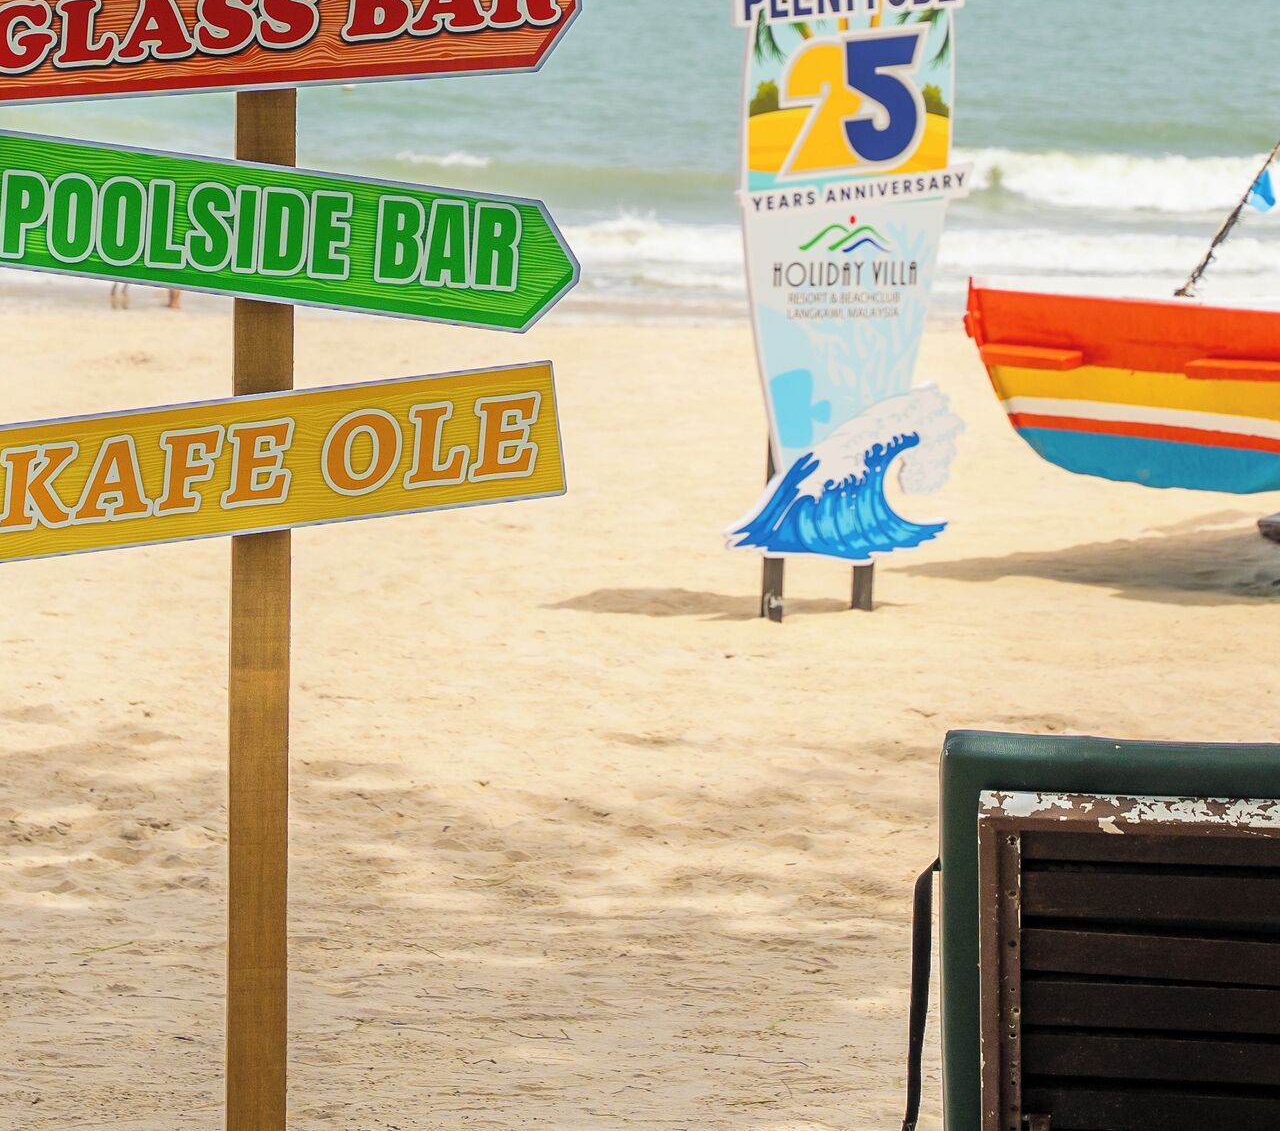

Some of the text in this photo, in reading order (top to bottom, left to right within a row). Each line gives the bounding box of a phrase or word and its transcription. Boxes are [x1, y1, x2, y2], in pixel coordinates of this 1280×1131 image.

[780, 33, 921, 174] 25
[751, 172, 968, 212] YEARS ANNIVERSARY
[375, 194, 522, 291] BAR
[773, 261, 918, 287] HOLIDAY VILLA
[322, 392, 542, 496] OLE
